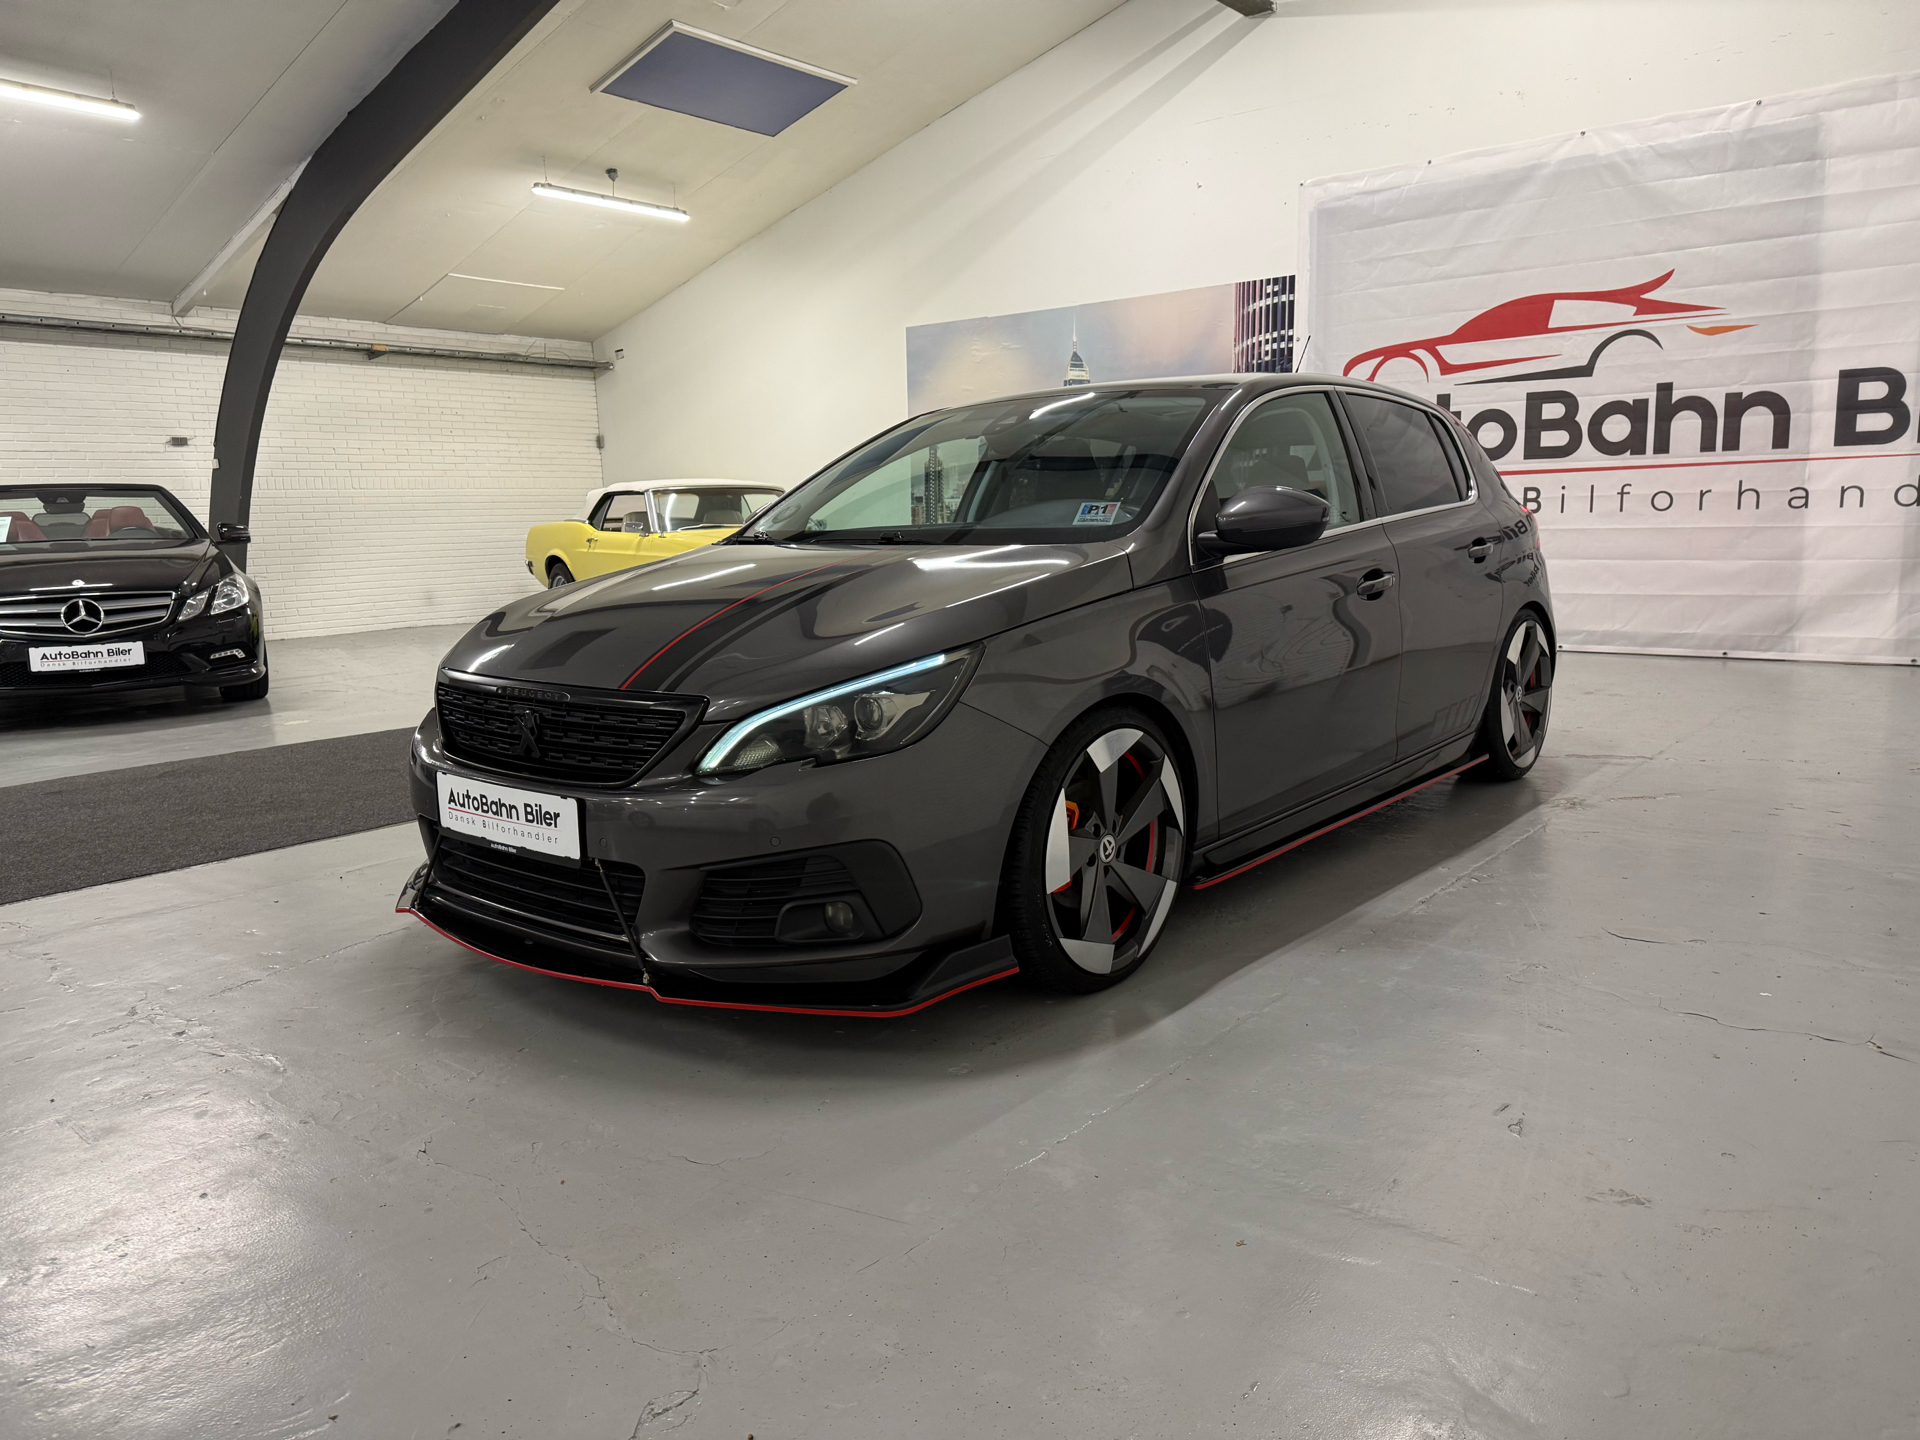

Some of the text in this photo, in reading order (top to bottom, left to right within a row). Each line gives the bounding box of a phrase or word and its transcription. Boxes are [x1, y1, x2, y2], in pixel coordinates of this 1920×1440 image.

[1834, 366, 1920, 447] B
[40, 647, 133, 661] AutoBahn Biler
[506, 687, 561, 700] PEUGEOT
[447, 787, 561, 829] AutoBahn Biler
[448, 811, 558, 844] Dansk Bilforhandler
